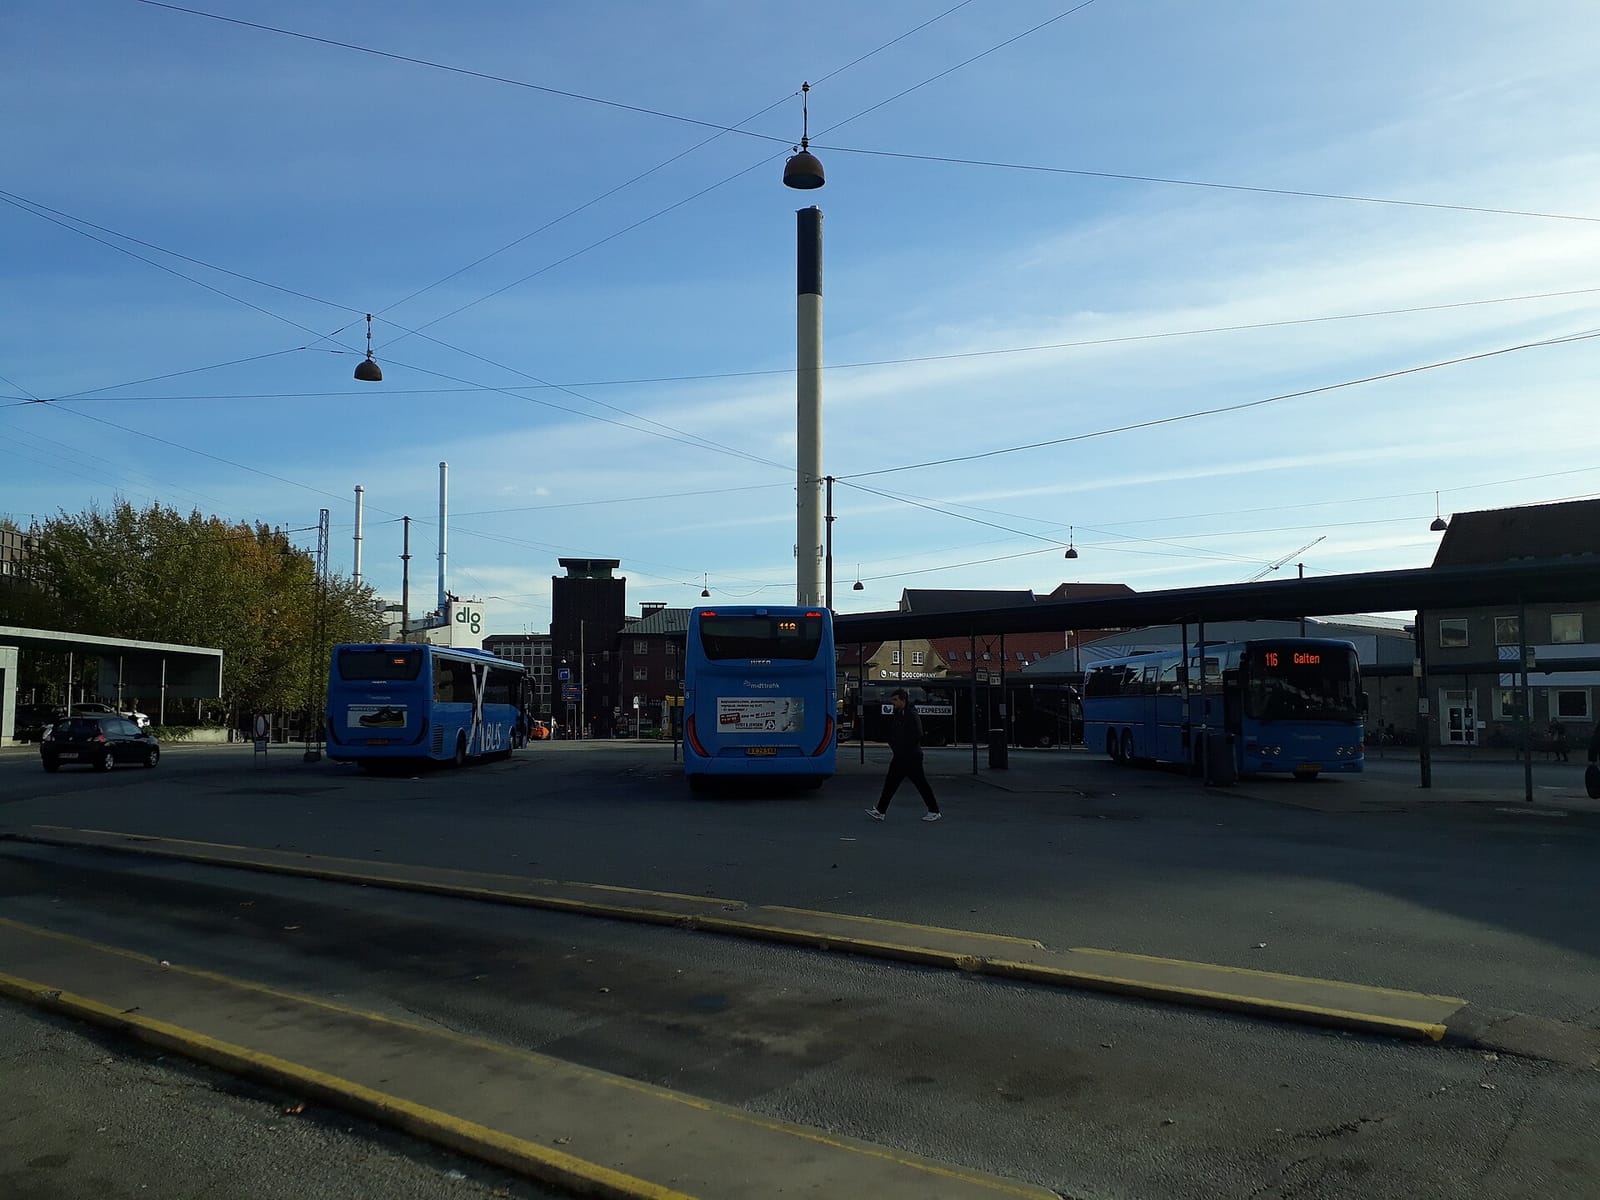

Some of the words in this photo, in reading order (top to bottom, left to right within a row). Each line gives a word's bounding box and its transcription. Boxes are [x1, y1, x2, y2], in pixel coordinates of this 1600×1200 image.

[456, 607, 481, 634] dlg
[1265, 652, 1278, 666] 116
[1293, 652, 1320, 664] Galten
